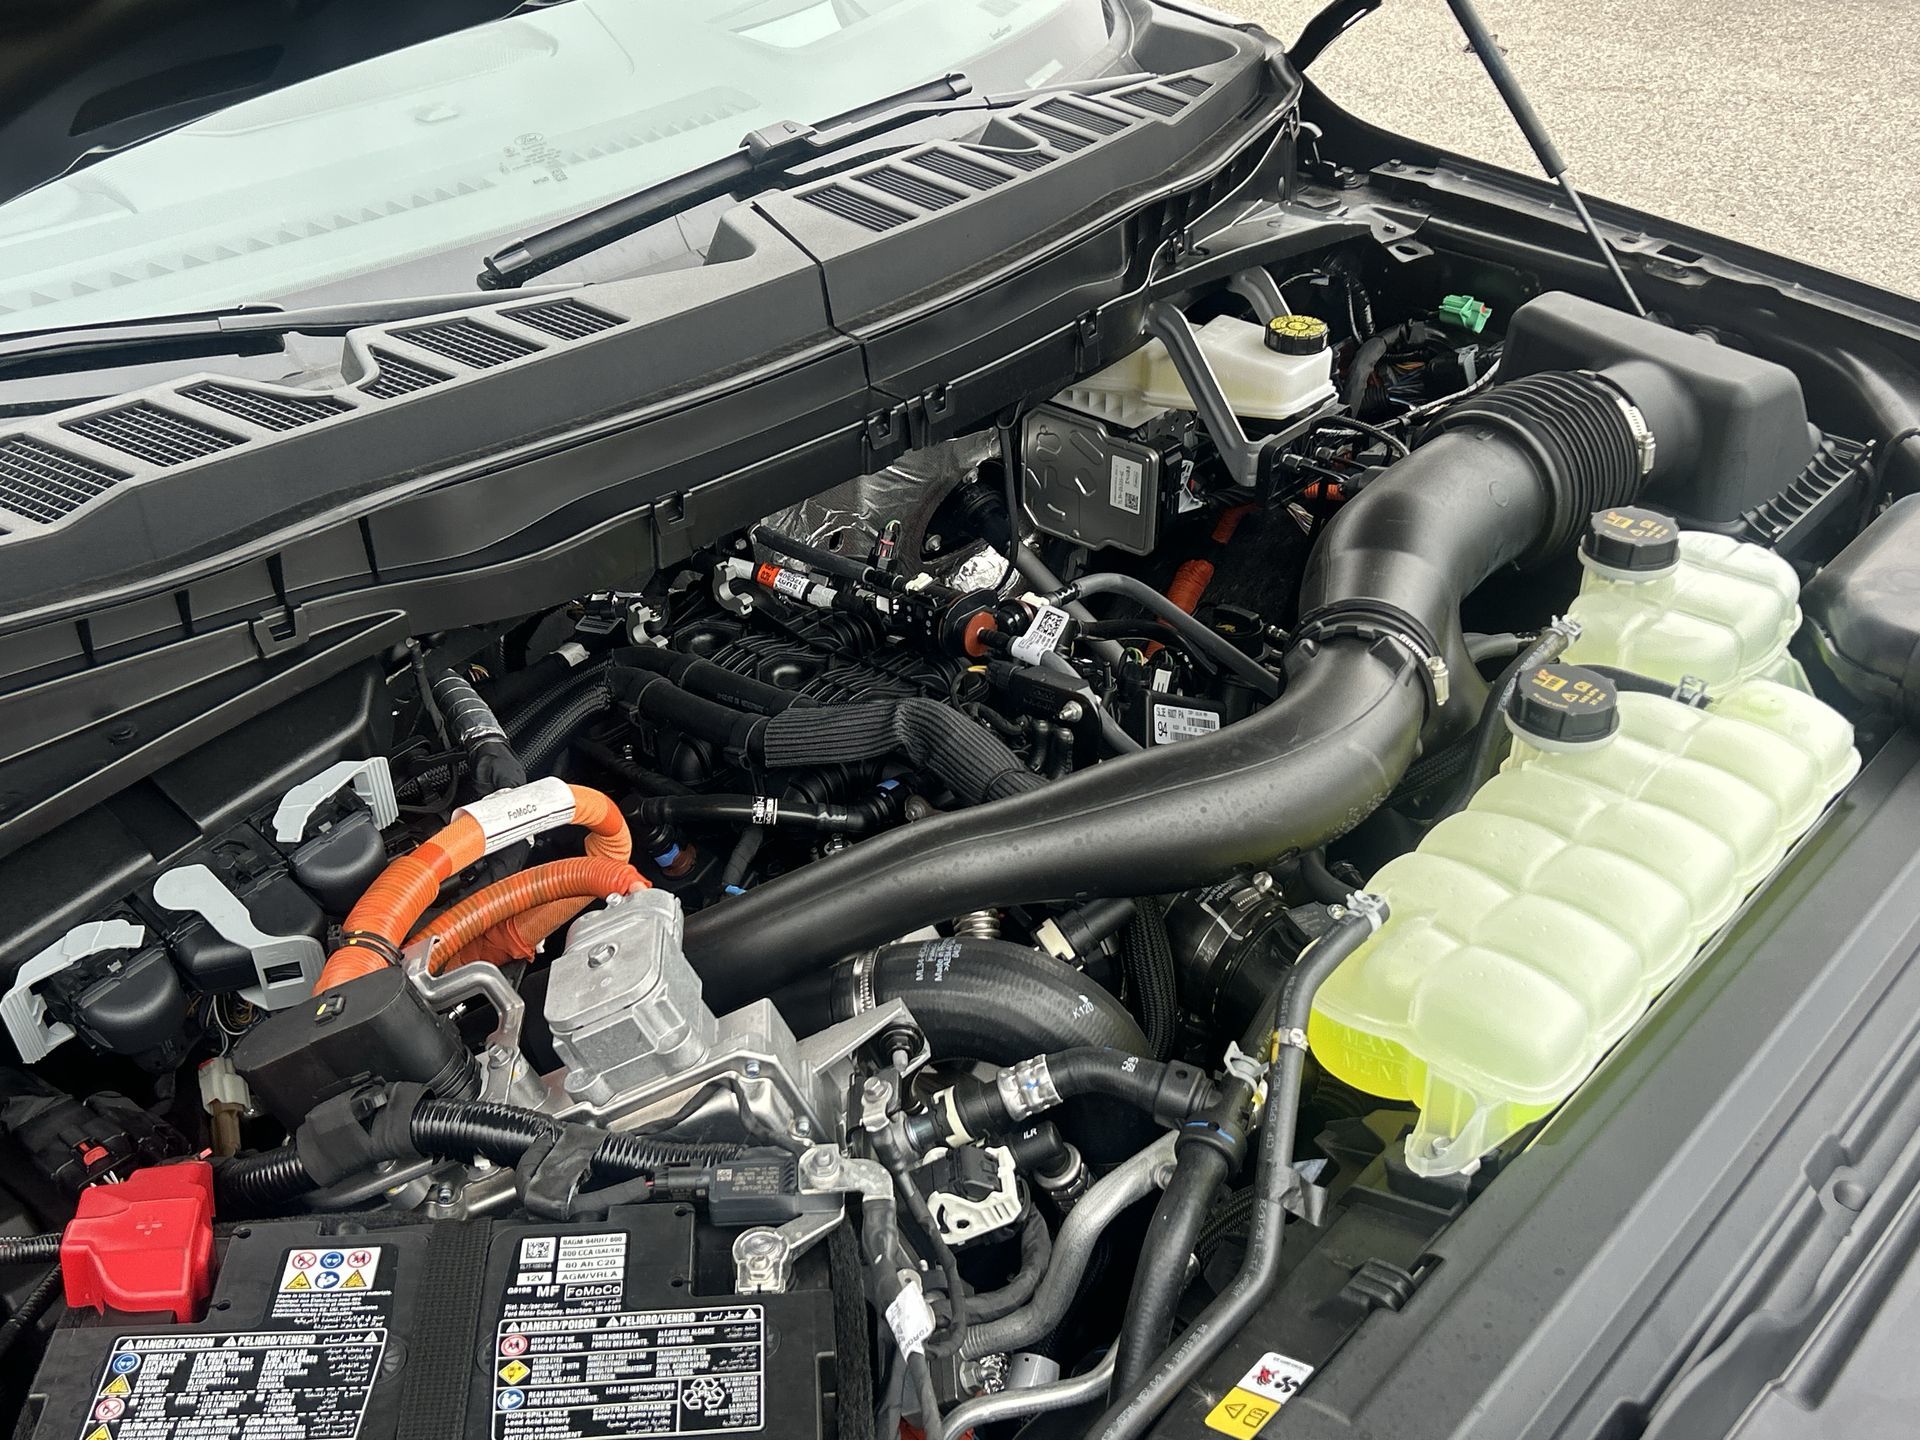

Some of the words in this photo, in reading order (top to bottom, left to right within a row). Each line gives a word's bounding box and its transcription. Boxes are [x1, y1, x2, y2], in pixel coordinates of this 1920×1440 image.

[1158, 721, 1168, 737] 94
[507, 804, 537, 820] FoMoCo
[1072, 1001, 1094, 1019] K120
[562, 1270, 618, 1281] AGM/VRLA
[535, 1285, 561, 1298] MF
[566, 1283, 621, 1298] FoMoCo
[504, 1310, 517, 1318] Ford
[536, 1308, 565, 1317] Company,
[565, 1306, 594, 1315] Dearborn,
[520, 1318, 597, 1332] DANGER/POISON
[620, 1312, 696, 1326] PELIGRO/VENENO
[134, 1338, 215, 1349] DANGER/POISON
[236, 1335, 317, 1346] PELIGRO/VENENO
[506, 1410, 568, 1419] NON-SPILLABLE
[593, 1406, 626, 1414] CONTRA
[628, 1404, 671, 1413] DERRAMES
[543, 1417, 570, 1425] Battery
